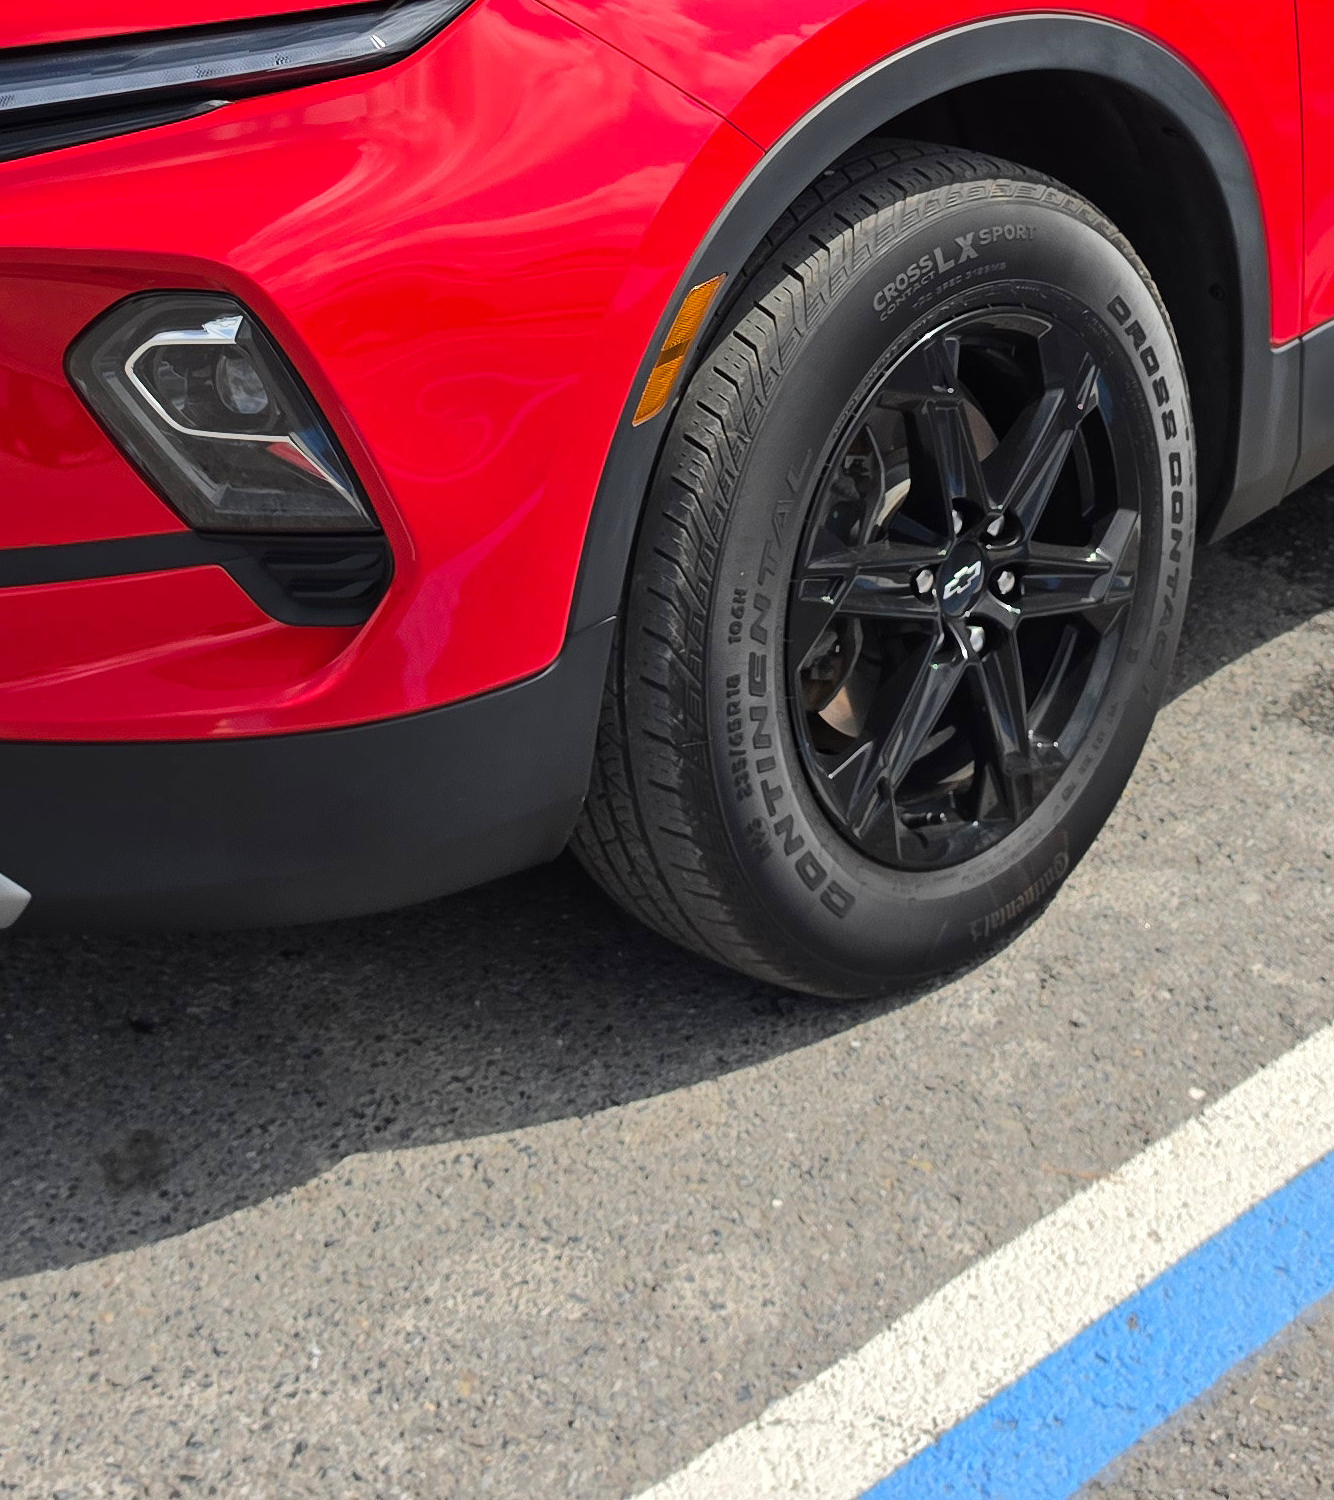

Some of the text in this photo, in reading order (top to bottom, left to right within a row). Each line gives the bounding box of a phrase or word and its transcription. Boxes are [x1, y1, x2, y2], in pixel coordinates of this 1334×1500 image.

[873, 223, 1037, 312] CROSS LX SPORT
[879, 270, 936, 322] CONTACT
[1141, 452, 1184, 696] CONTAC
[748, 448, 856, 919] CONTINENTAL
